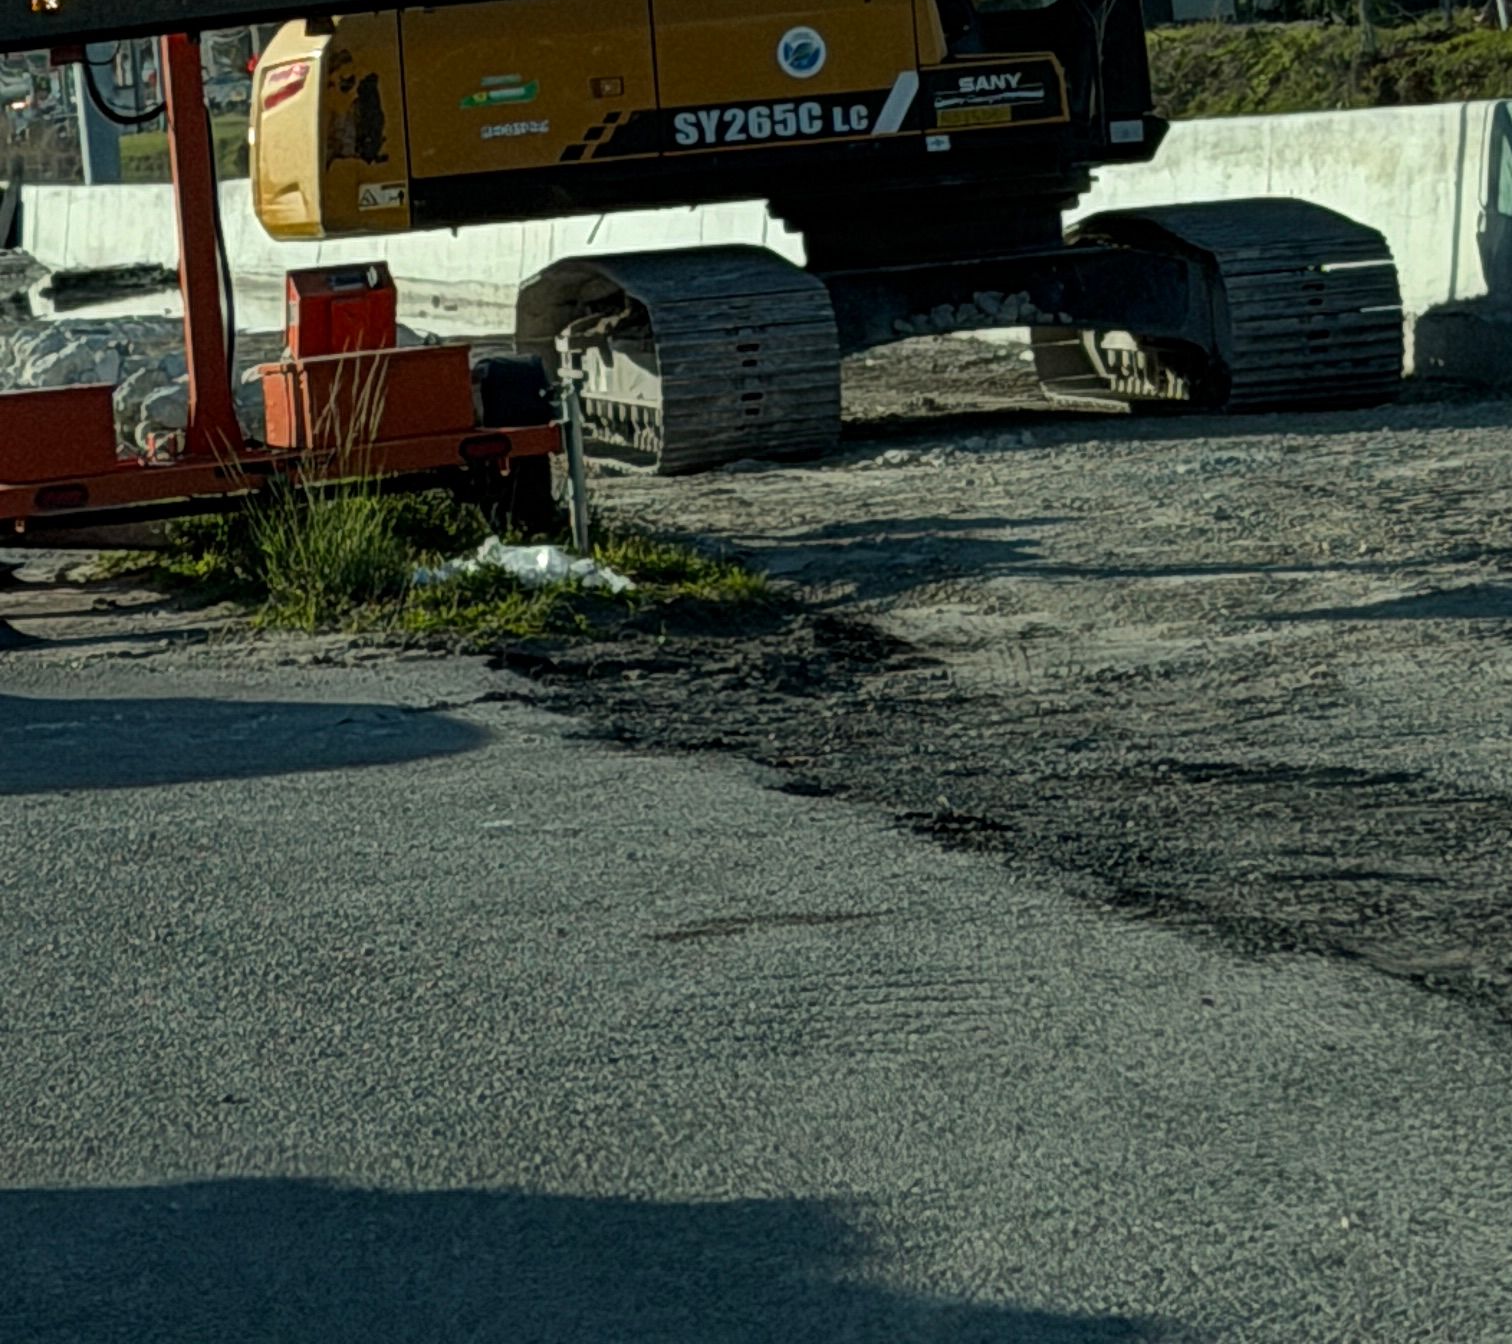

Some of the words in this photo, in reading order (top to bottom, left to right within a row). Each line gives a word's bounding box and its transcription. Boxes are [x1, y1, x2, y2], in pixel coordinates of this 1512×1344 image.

[958, 72, 1022, 92] SANY
[674, 102, 823, 145] SY265C
[832, 105, 869, 132] LC
